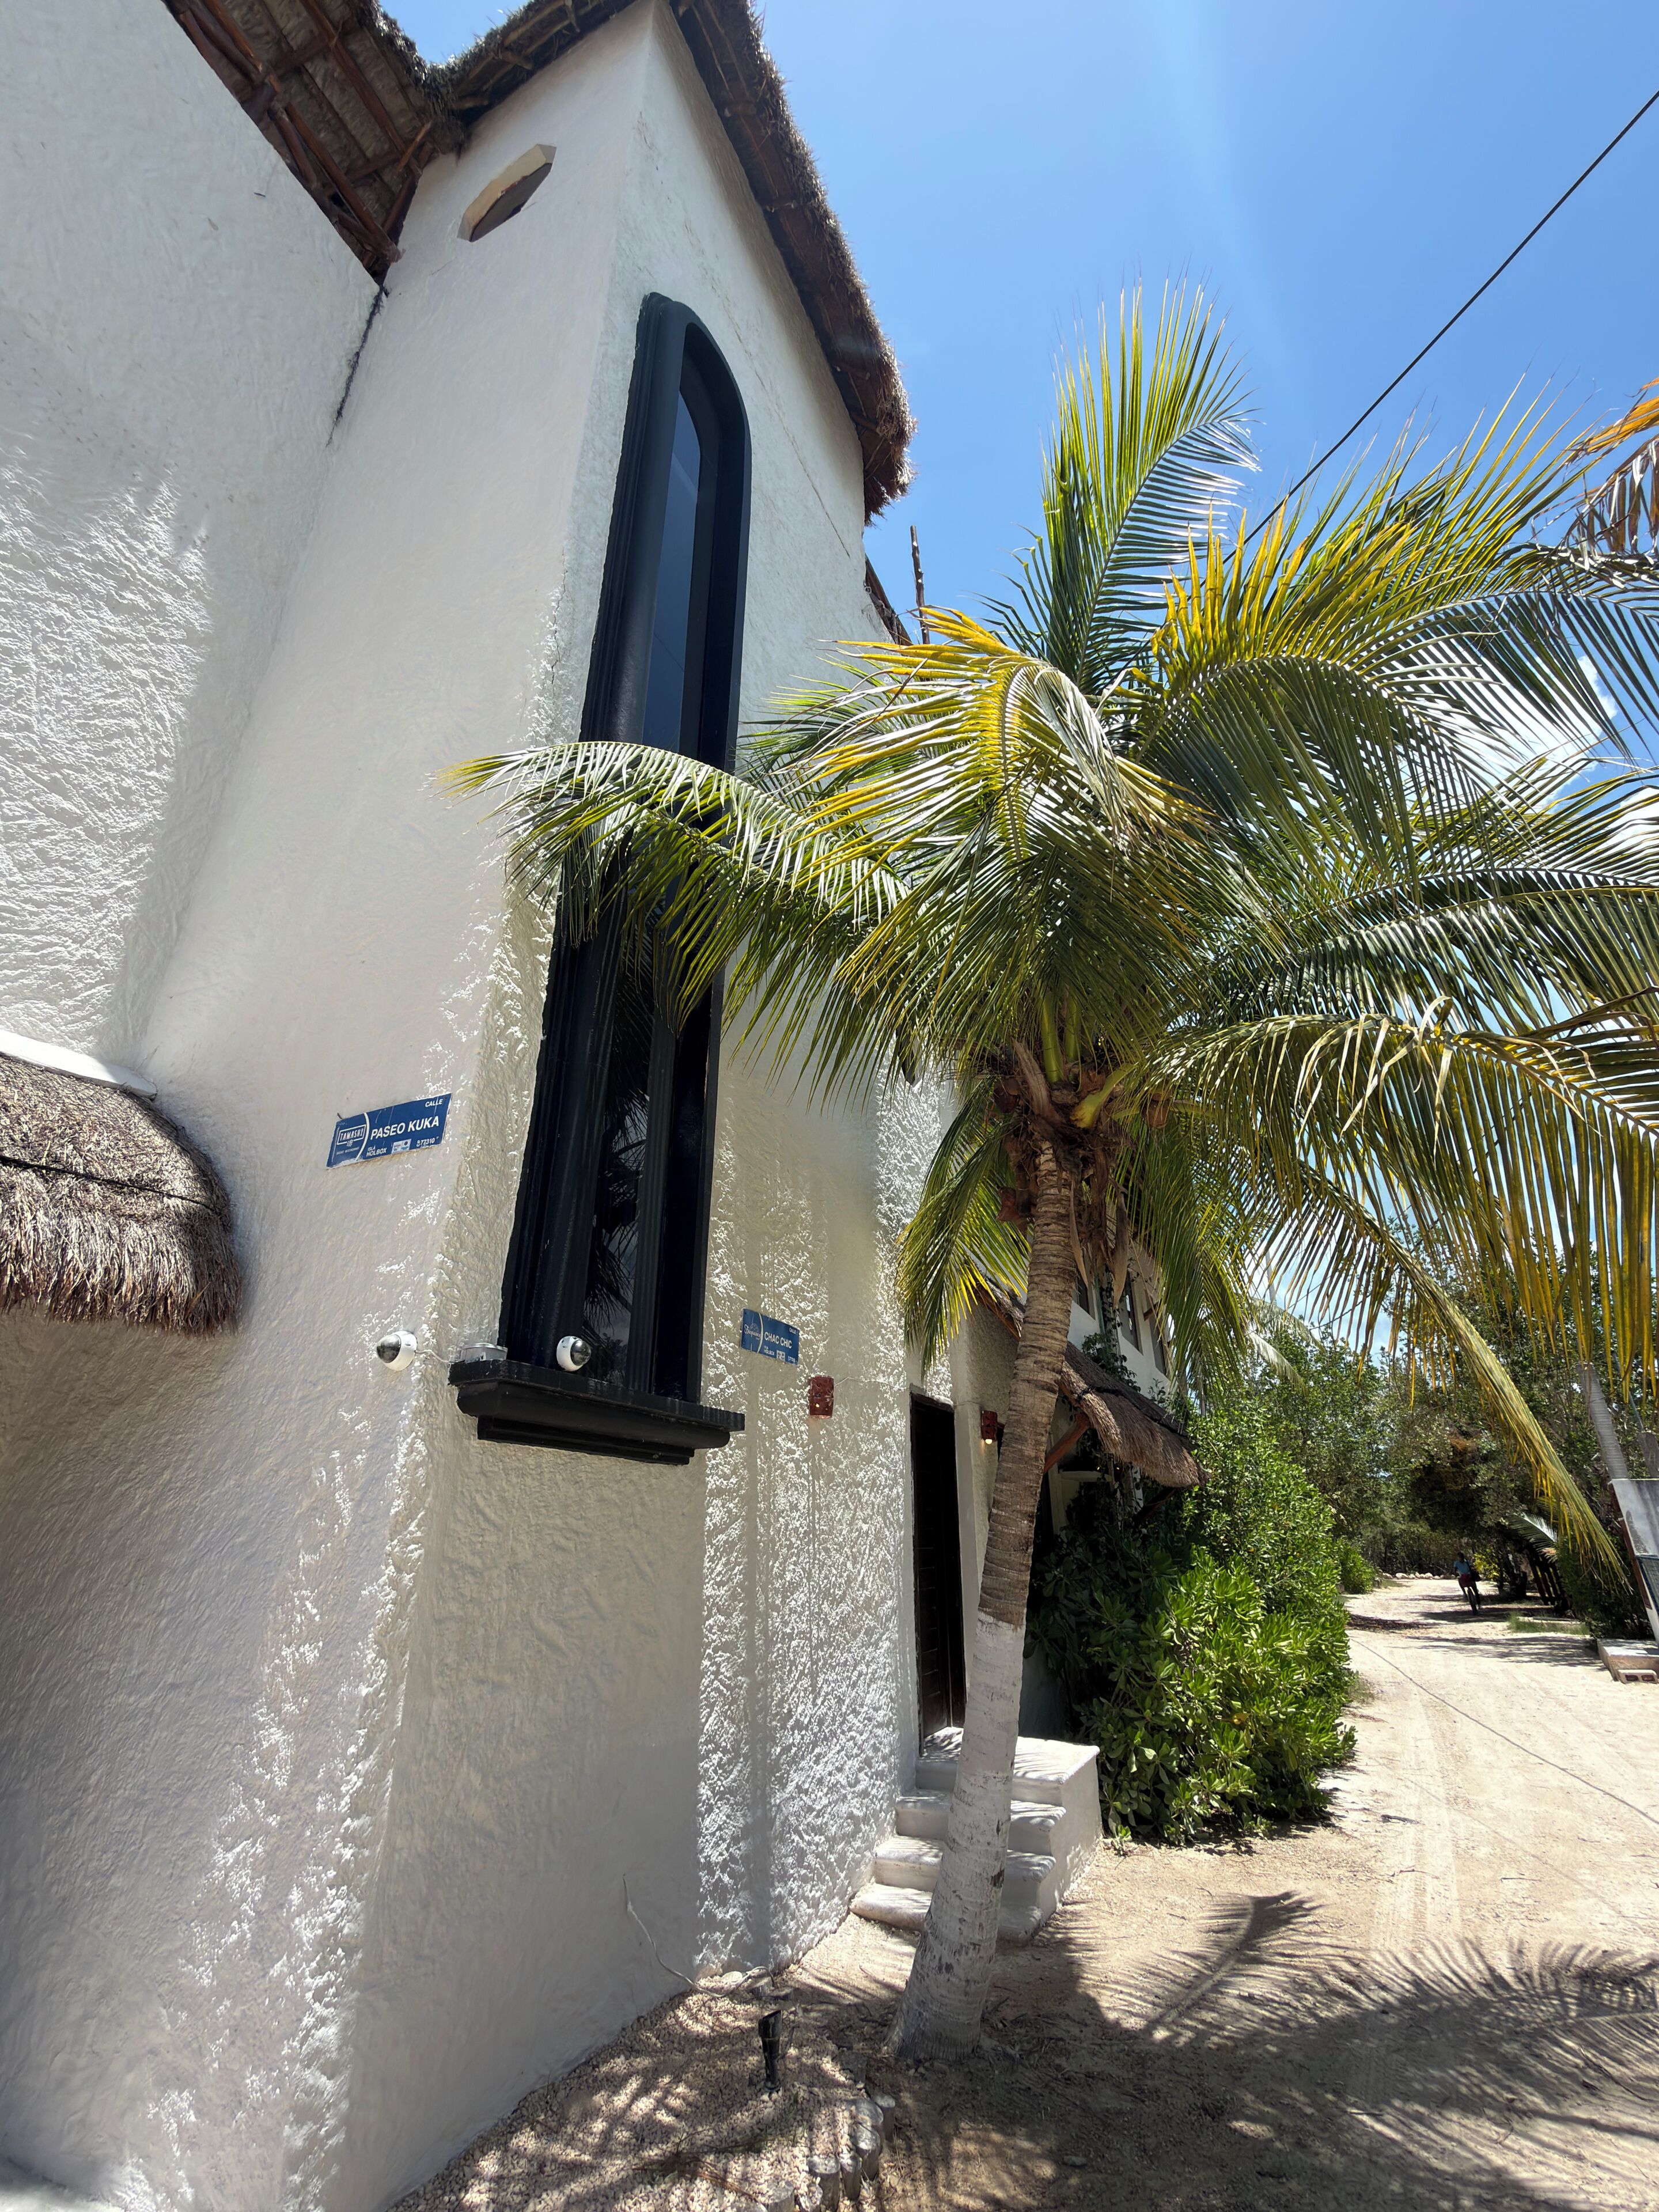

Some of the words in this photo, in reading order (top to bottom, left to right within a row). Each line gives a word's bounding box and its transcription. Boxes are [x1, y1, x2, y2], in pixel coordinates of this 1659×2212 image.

[425, 1099, 443, 1107] CALLE
[370, 1123, 406, 1140] PASEO
[407, 1115, 439, 1132] KUKA
[366, 1147, 387, 1157] HOLBOX
[764, 1332, 779, 1344] CHAC
[780, 1337, 792, 1349] CHIC
